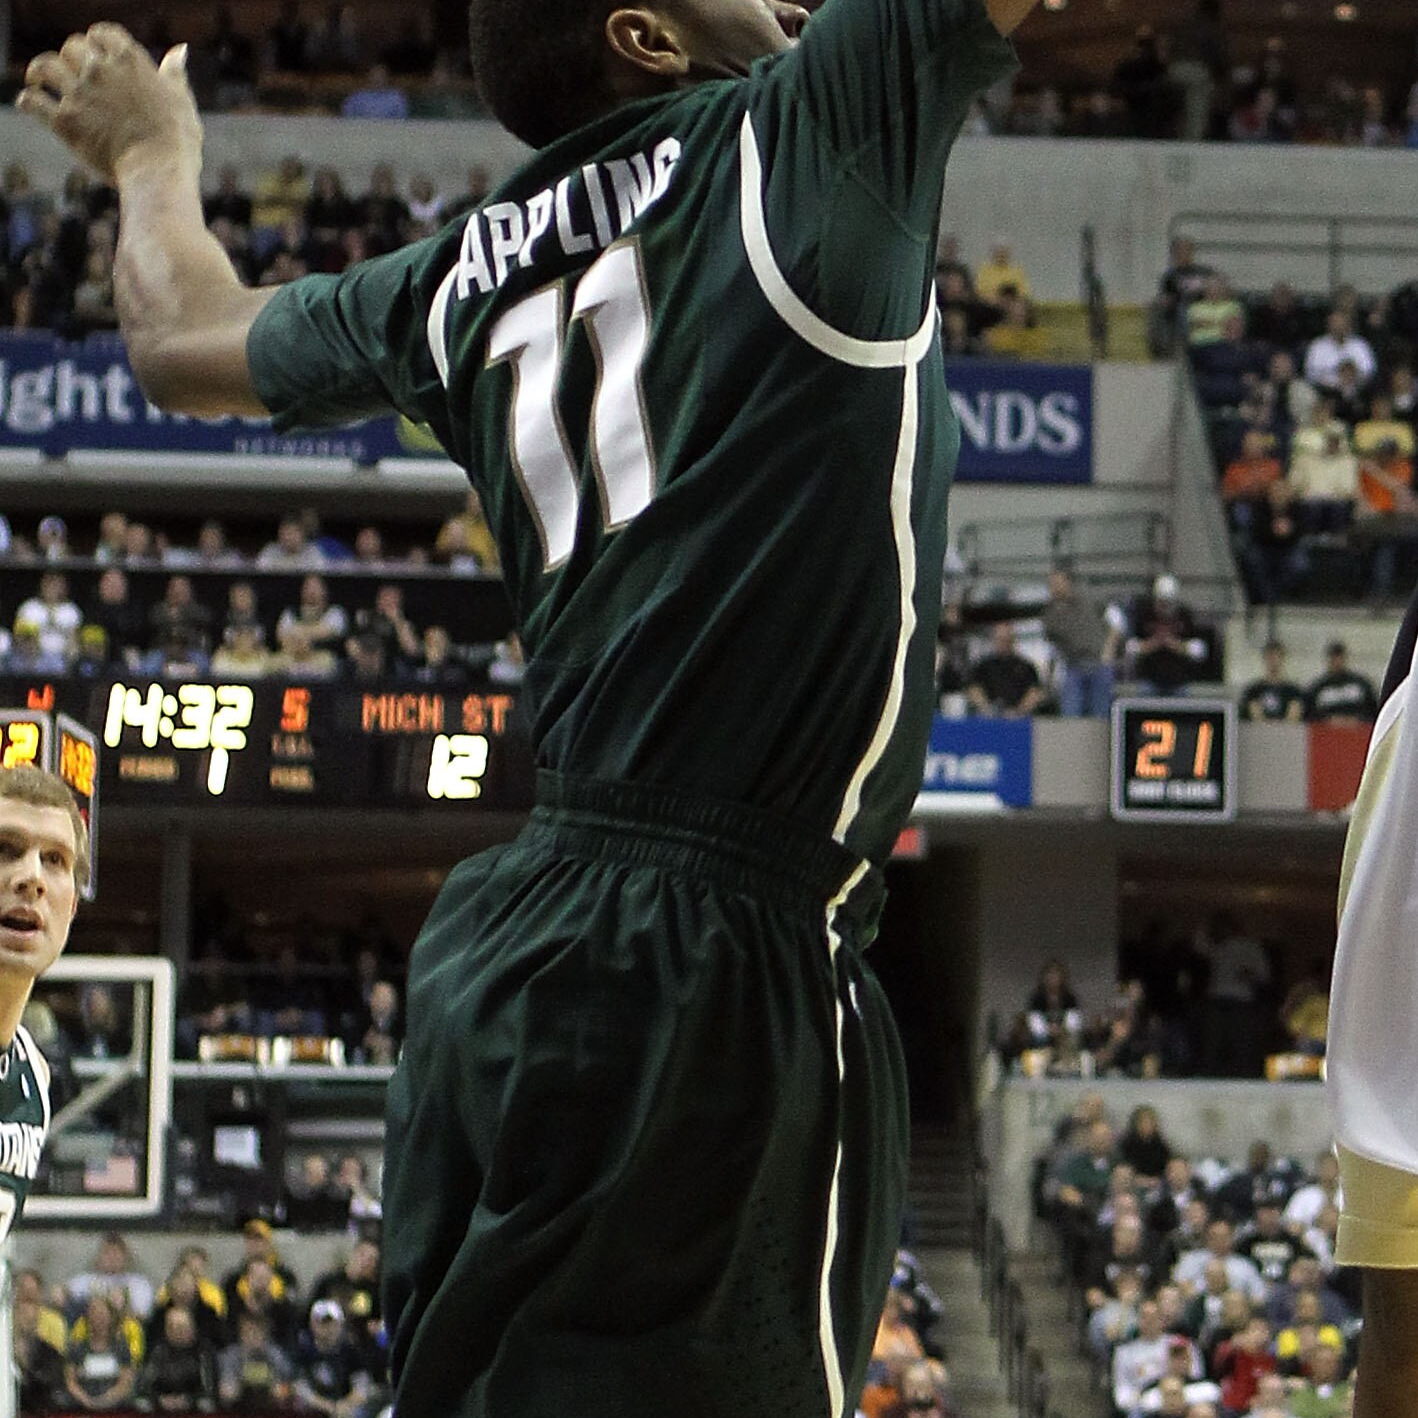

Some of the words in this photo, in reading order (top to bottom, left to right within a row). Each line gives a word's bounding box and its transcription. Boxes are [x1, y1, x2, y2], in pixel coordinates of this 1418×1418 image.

[457, 136, 683, 301] APPLING
[485, 234, 658, 575] 11
[103, 682, 254, 750] 14:32
[281, 687, 311, 733] 5
[362, 693, 444, 733] MICH
[462, 694, 513, 734] ST
[207, 746, 230, 796] 1
[427, 733, 489, 800] 12
[1135, 719, 1214, 781] 21
